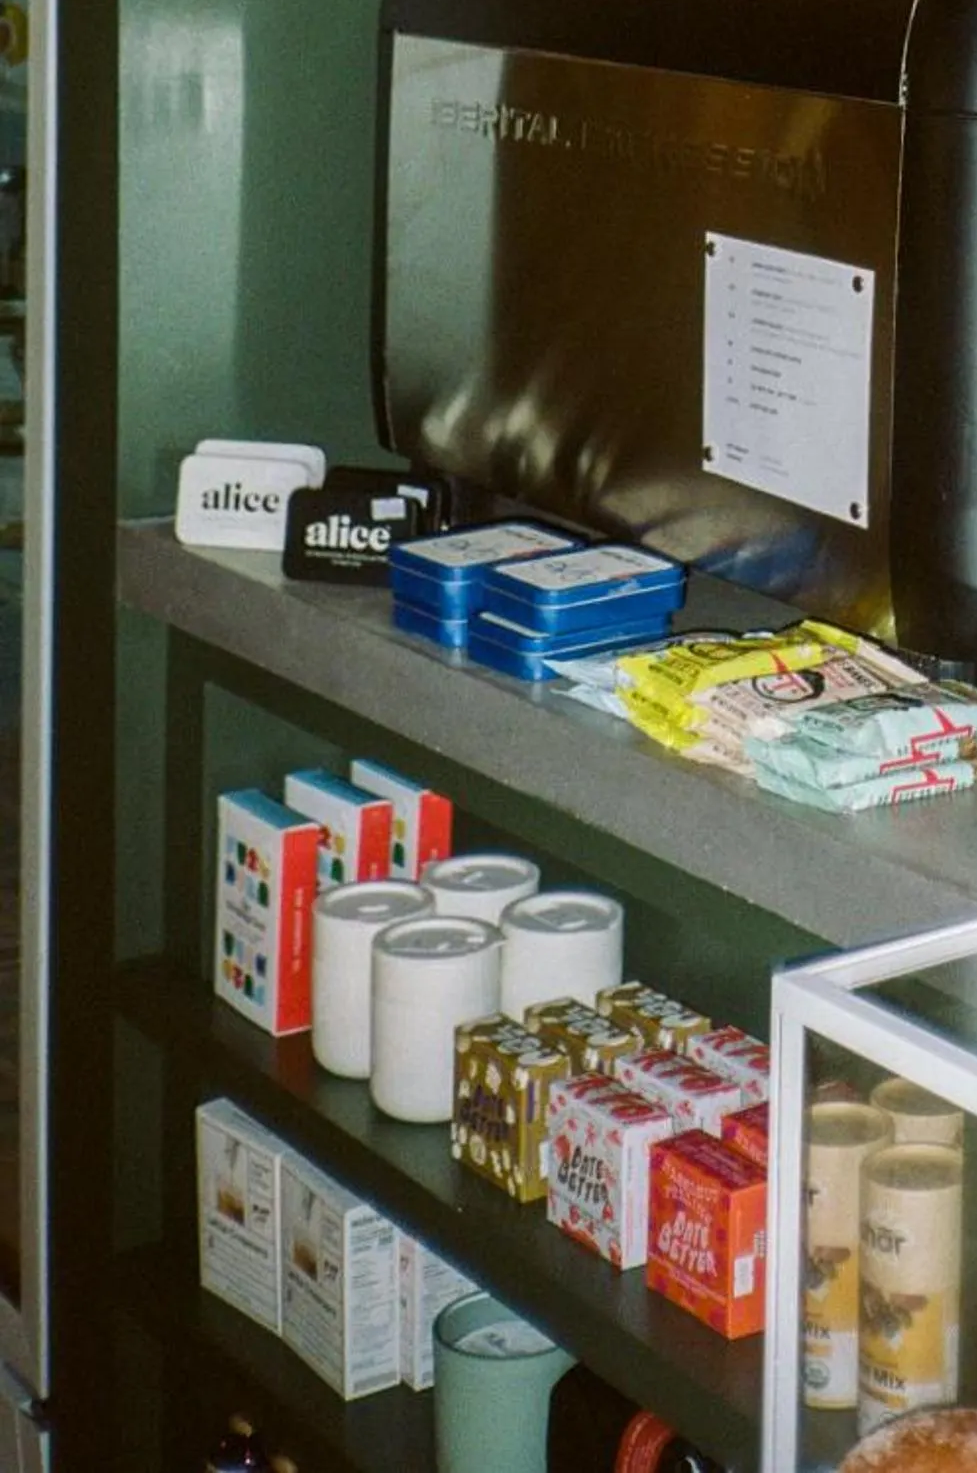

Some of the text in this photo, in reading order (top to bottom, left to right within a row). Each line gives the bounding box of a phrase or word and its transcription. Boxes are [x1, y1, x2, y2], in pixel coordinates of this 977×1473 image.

[202, 481, 280, 514] alice
[304, 515, 391, 553] alice
[572, 1145, 604, 1179] DATE
[558, 1163, 609, 1204] BETTER
[673, 1211, 710, 1248] DATE
[658, 1223, 718, 1277] BETTER
